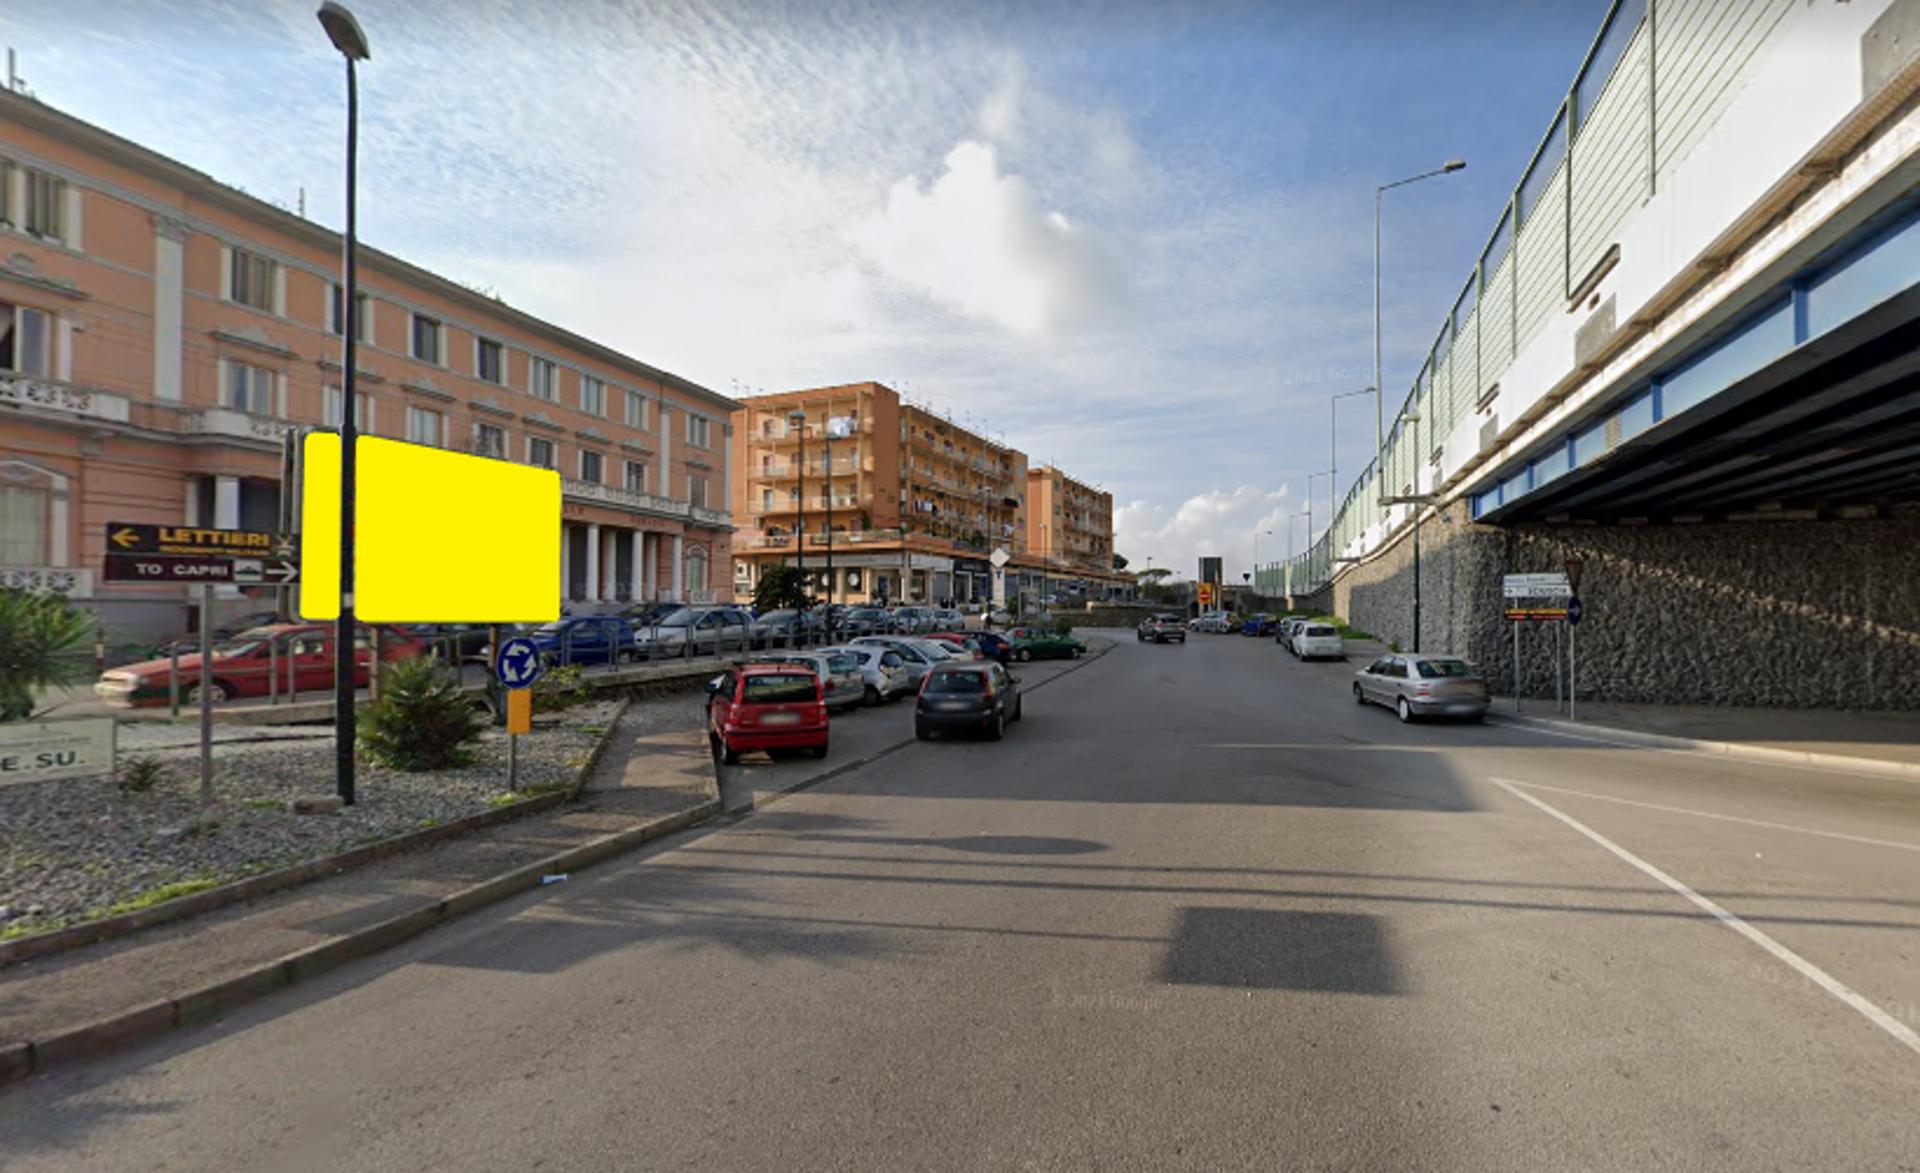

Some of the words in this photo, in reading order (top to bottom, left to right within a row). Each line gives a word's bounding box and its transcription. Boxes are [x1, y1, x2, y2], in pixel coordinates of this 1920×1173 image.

[158, 528, 269, 546] LETTIERI
[135, 564, 163, 574] TO
[173, 565, 228, 576] CAPRI
